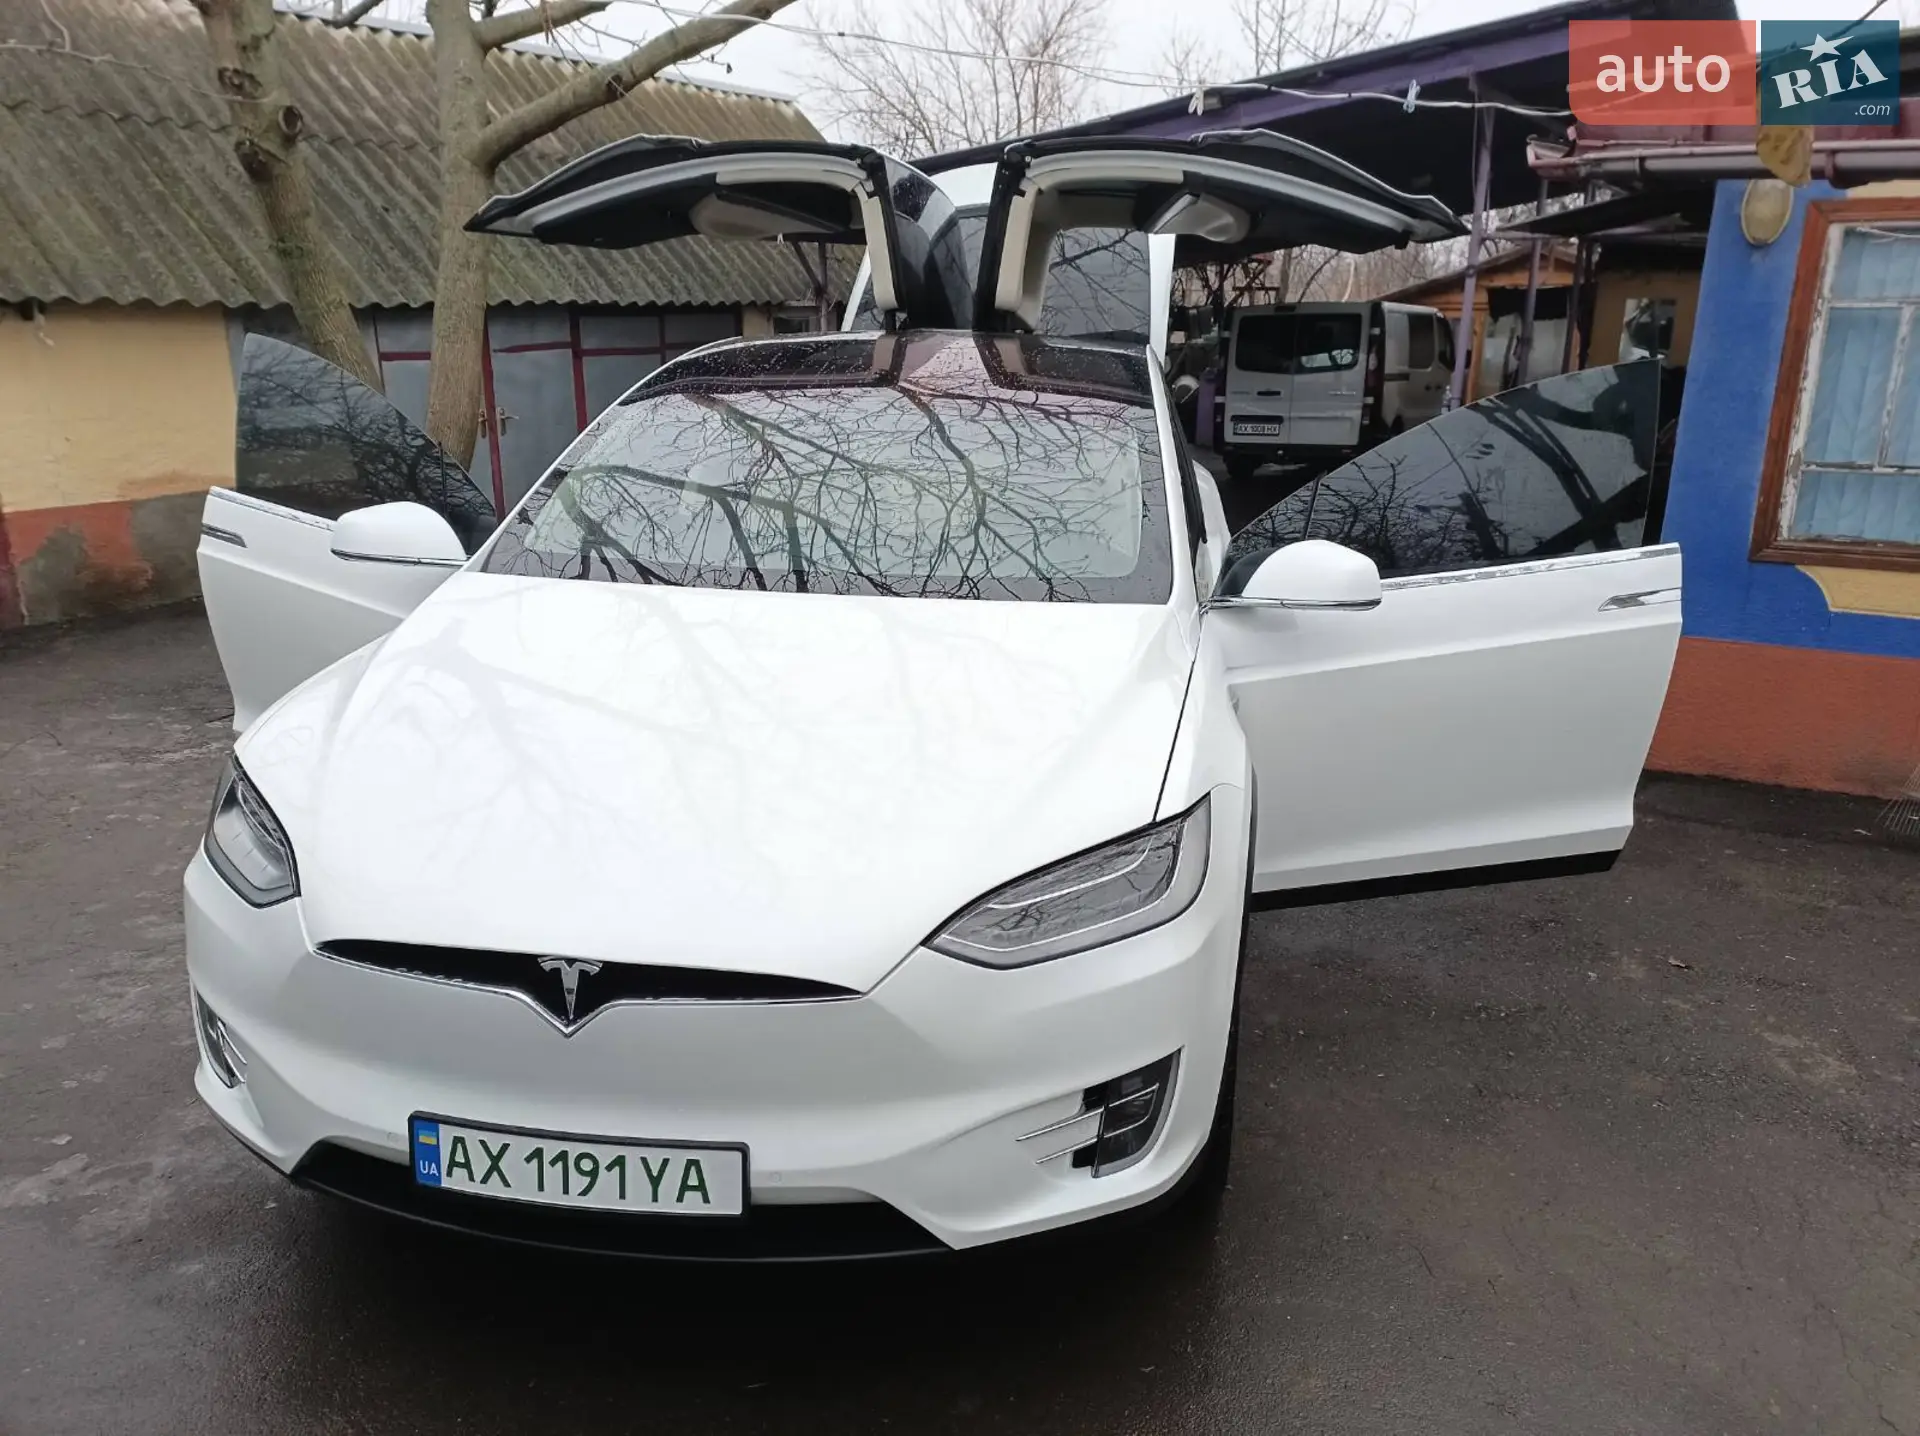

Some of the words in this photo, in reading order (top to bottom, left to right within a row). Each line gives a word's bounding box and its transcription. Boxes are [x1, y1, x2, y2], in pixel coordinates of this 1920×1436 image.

[420, 1159, 439, 1176] UA
[446, 1135, 512, 1188] AX
[523, 1147, 627, 1200] 1191
[640, 1156, 711, 1204] YA
